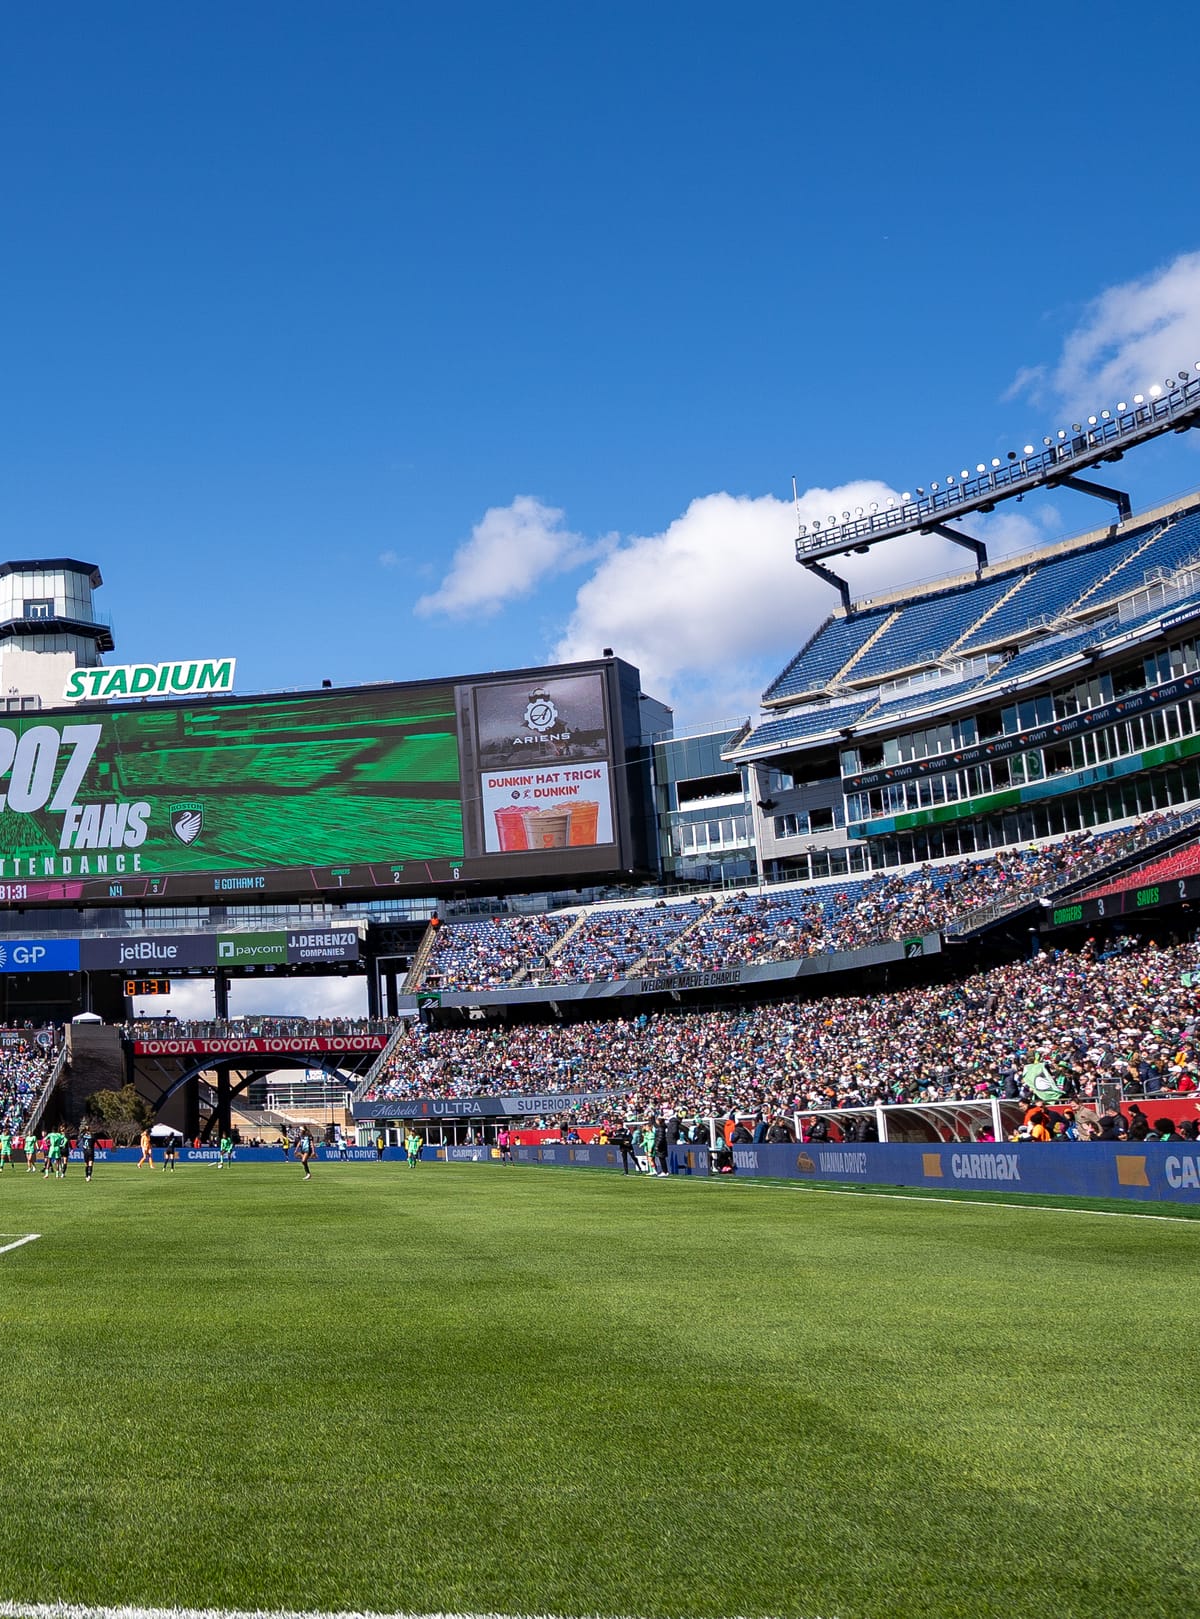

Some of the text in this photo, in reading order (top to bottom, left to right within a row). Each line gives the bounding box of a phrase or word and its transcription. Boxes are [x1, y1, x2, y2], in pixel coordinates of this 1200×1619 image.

[66, 661, 232, 697] STADIUM
[513, 733, 571, 745] ARIENS
[488, 769, 601, 789] DUNKIN' HAT TRICK
[534, 785, 580, 798] DUNKIN'
[59, 802, 151, 849] FANS
[394, 872, 400, 883] 2
[453, 868, 459, 880] 6
[222, 878, 253, 889] GOTHAM
[255, 877, 264, 888] FC
[1137, 880, 1187, 907] SAVES 2
[1053, 898, 1104, 925] CORNERS 3
[289, 933, 356, 948] J.DERENZO
[119, 943, 177, 963] jetBlue
[236, 945, 283, 957] paycom
[300, 948, 345, 958] COMPANIES
[126, 980, 169, 995] 81:31
[640, 978, 677, 992] WELCOME
[140, 1036, 382, 1054] TOYOTA TOYOTA TOYOTA TOYOTA
[371, 1101, 482, 1117] Michelob ULTRA
[518, 1098, 570, 1111] SUPERIOR
[820, 1152, 867, 1174] WANNA DRIVE?
